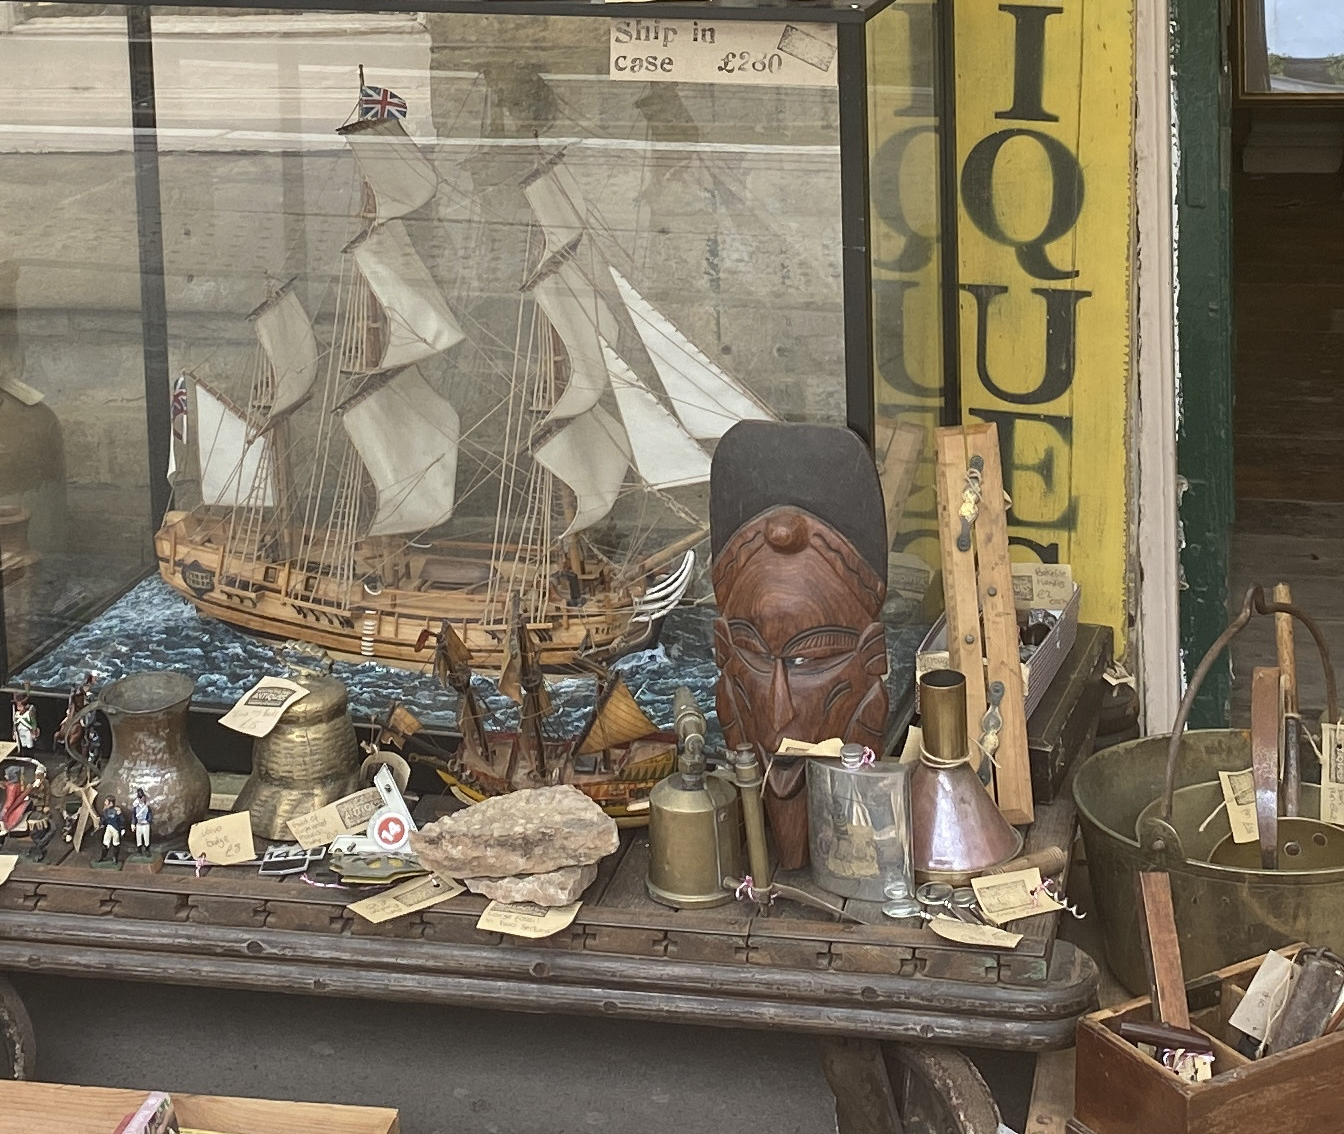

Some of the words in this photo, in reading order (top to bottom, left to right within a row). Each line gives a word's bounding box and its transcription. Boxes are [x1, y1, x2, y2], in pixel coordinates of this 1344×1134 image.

[614, 19, 678, 48] Ship
[692, 21, 716, 44] in
[614, 54, 674, 73] case
[381, 820, 403, 841] 14
